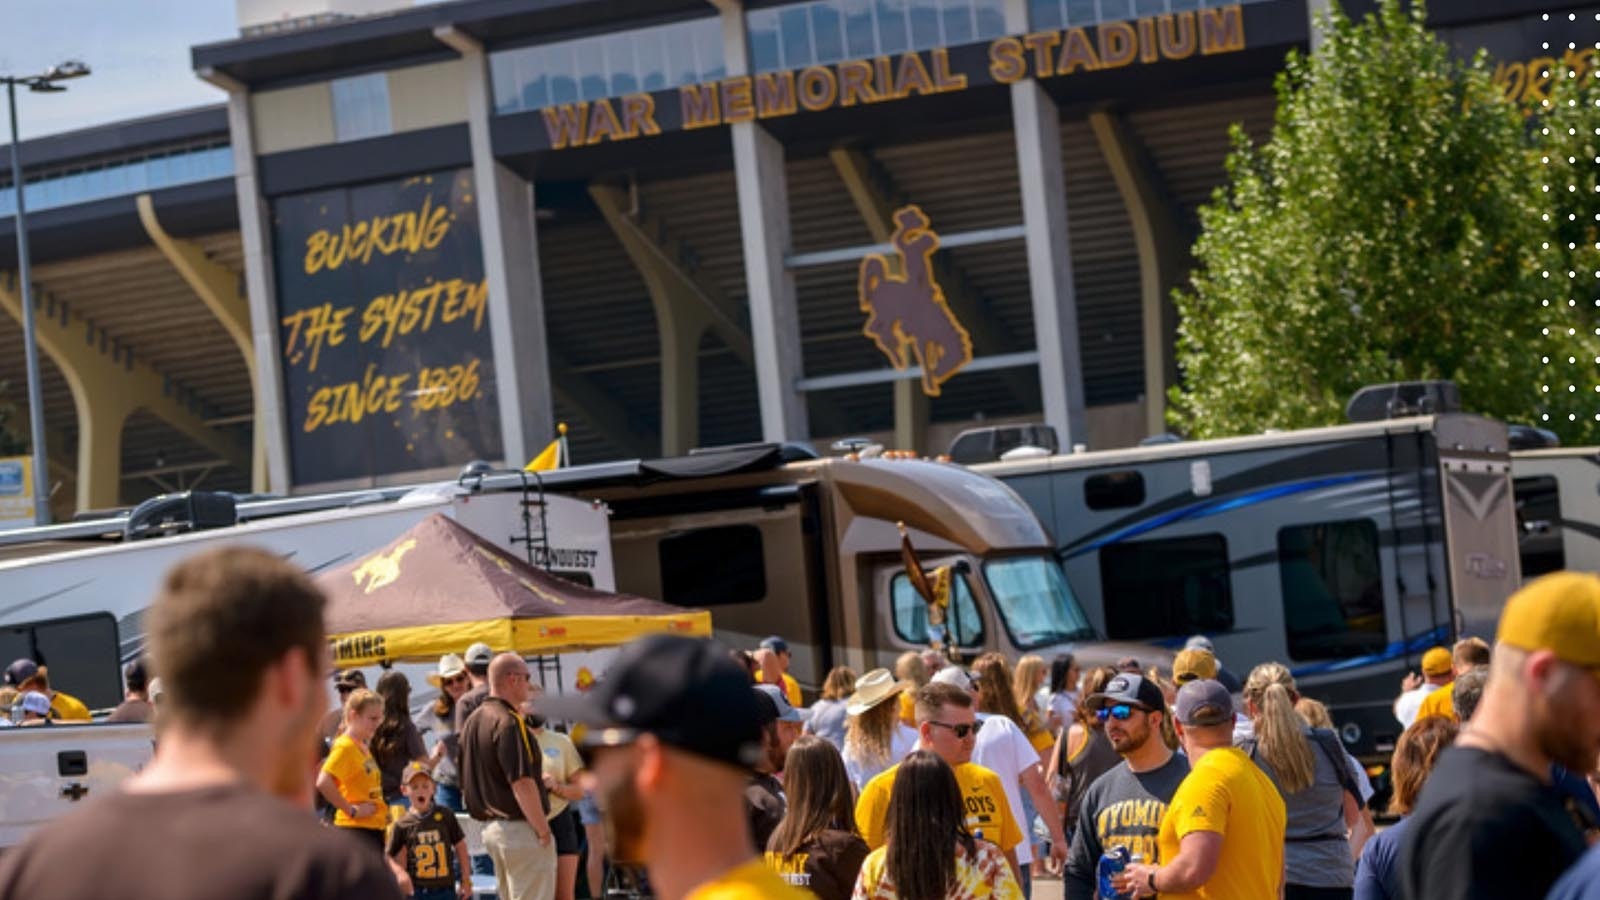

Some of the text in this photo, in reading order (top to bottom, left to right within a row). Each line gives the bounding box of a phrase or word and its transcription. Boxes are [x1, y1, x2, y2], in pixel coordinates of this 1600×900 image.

[540, 5, 1246, 150] WAR MEMORIAL STADIUM
[304, 195, 449, 275] BUCKING
[283, 278, 488, 373] THE SYSTEM
[304, 363, 410, 433] SINCE
[415, 842, 449, 879] 21
